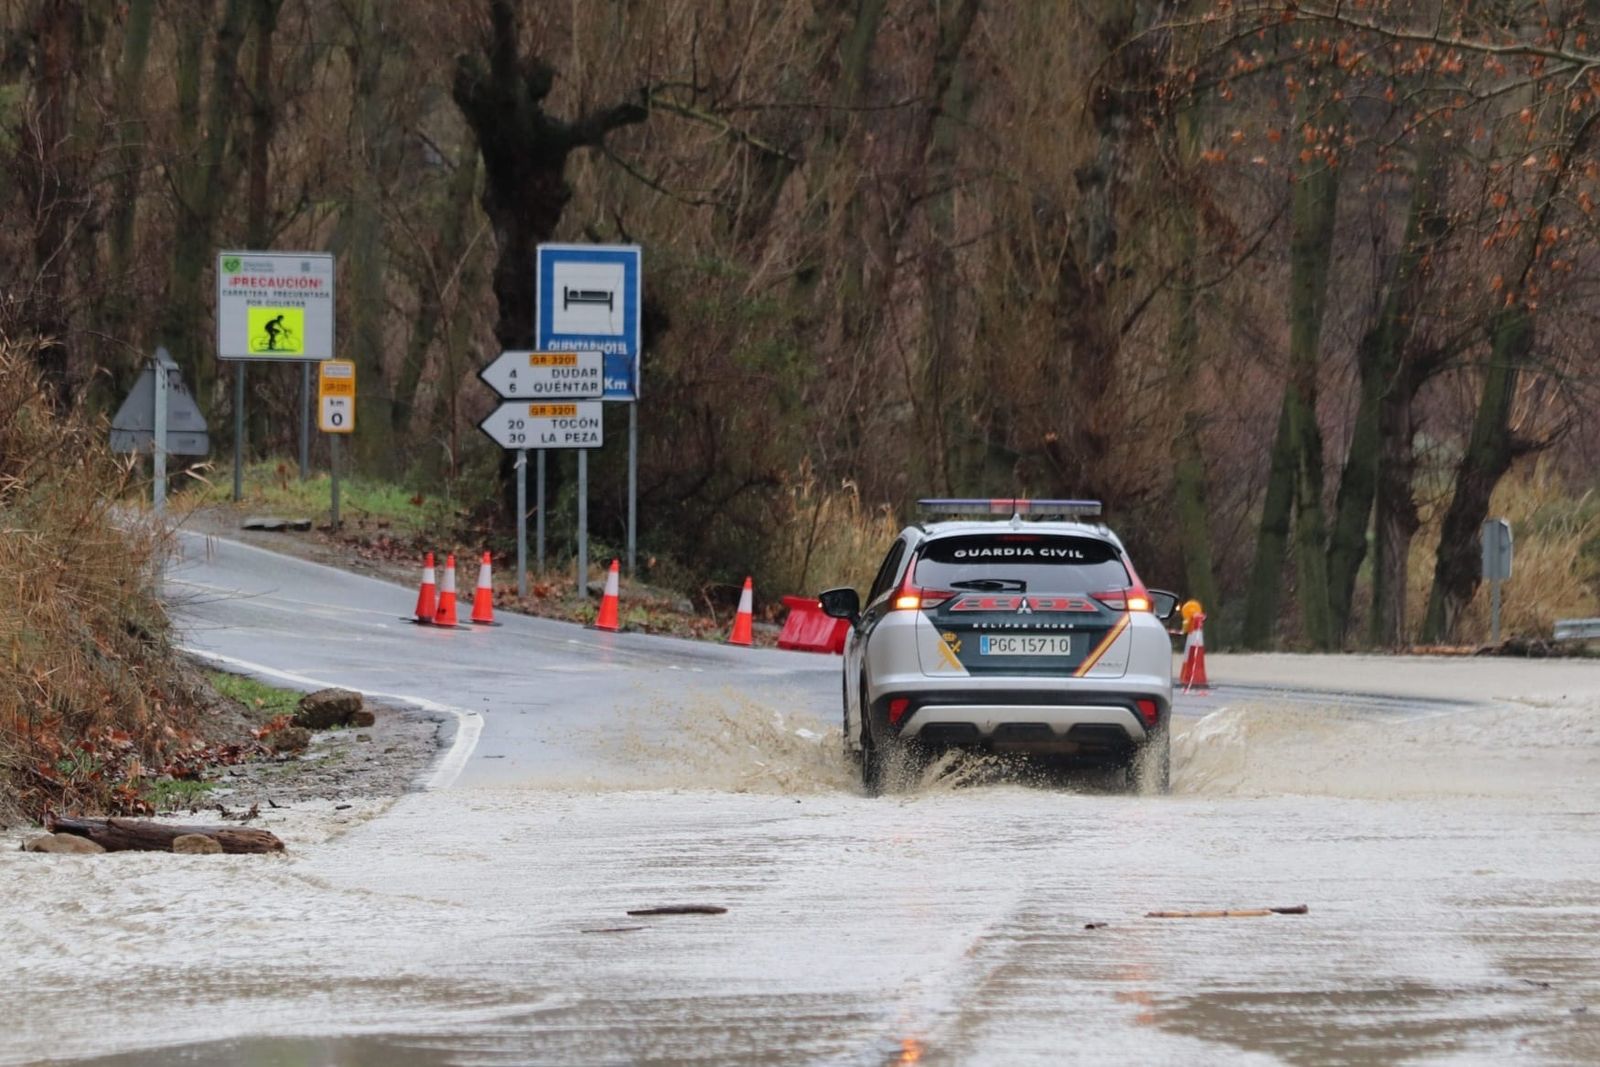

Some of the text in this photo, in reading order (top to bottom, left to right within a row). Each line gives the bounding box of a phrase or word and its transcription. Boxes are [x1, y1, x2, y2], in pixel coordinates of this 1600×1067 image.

[509, 368, 598, 378] 4 DUDAR
[509, 383, 517, 393] 6
[604, 377, 627, 390] Km
[330, 398, 345, 406] km
[331, 413, 343, 426] 0
[508, 417, 599, 430] 20 TOCÓN
[509, 432, 598, 443] 30 LA PEZA
[954, 548, 1084, 559] GUARDIA CIVIL
[989, 638, 1069, 653] PGC 15710
